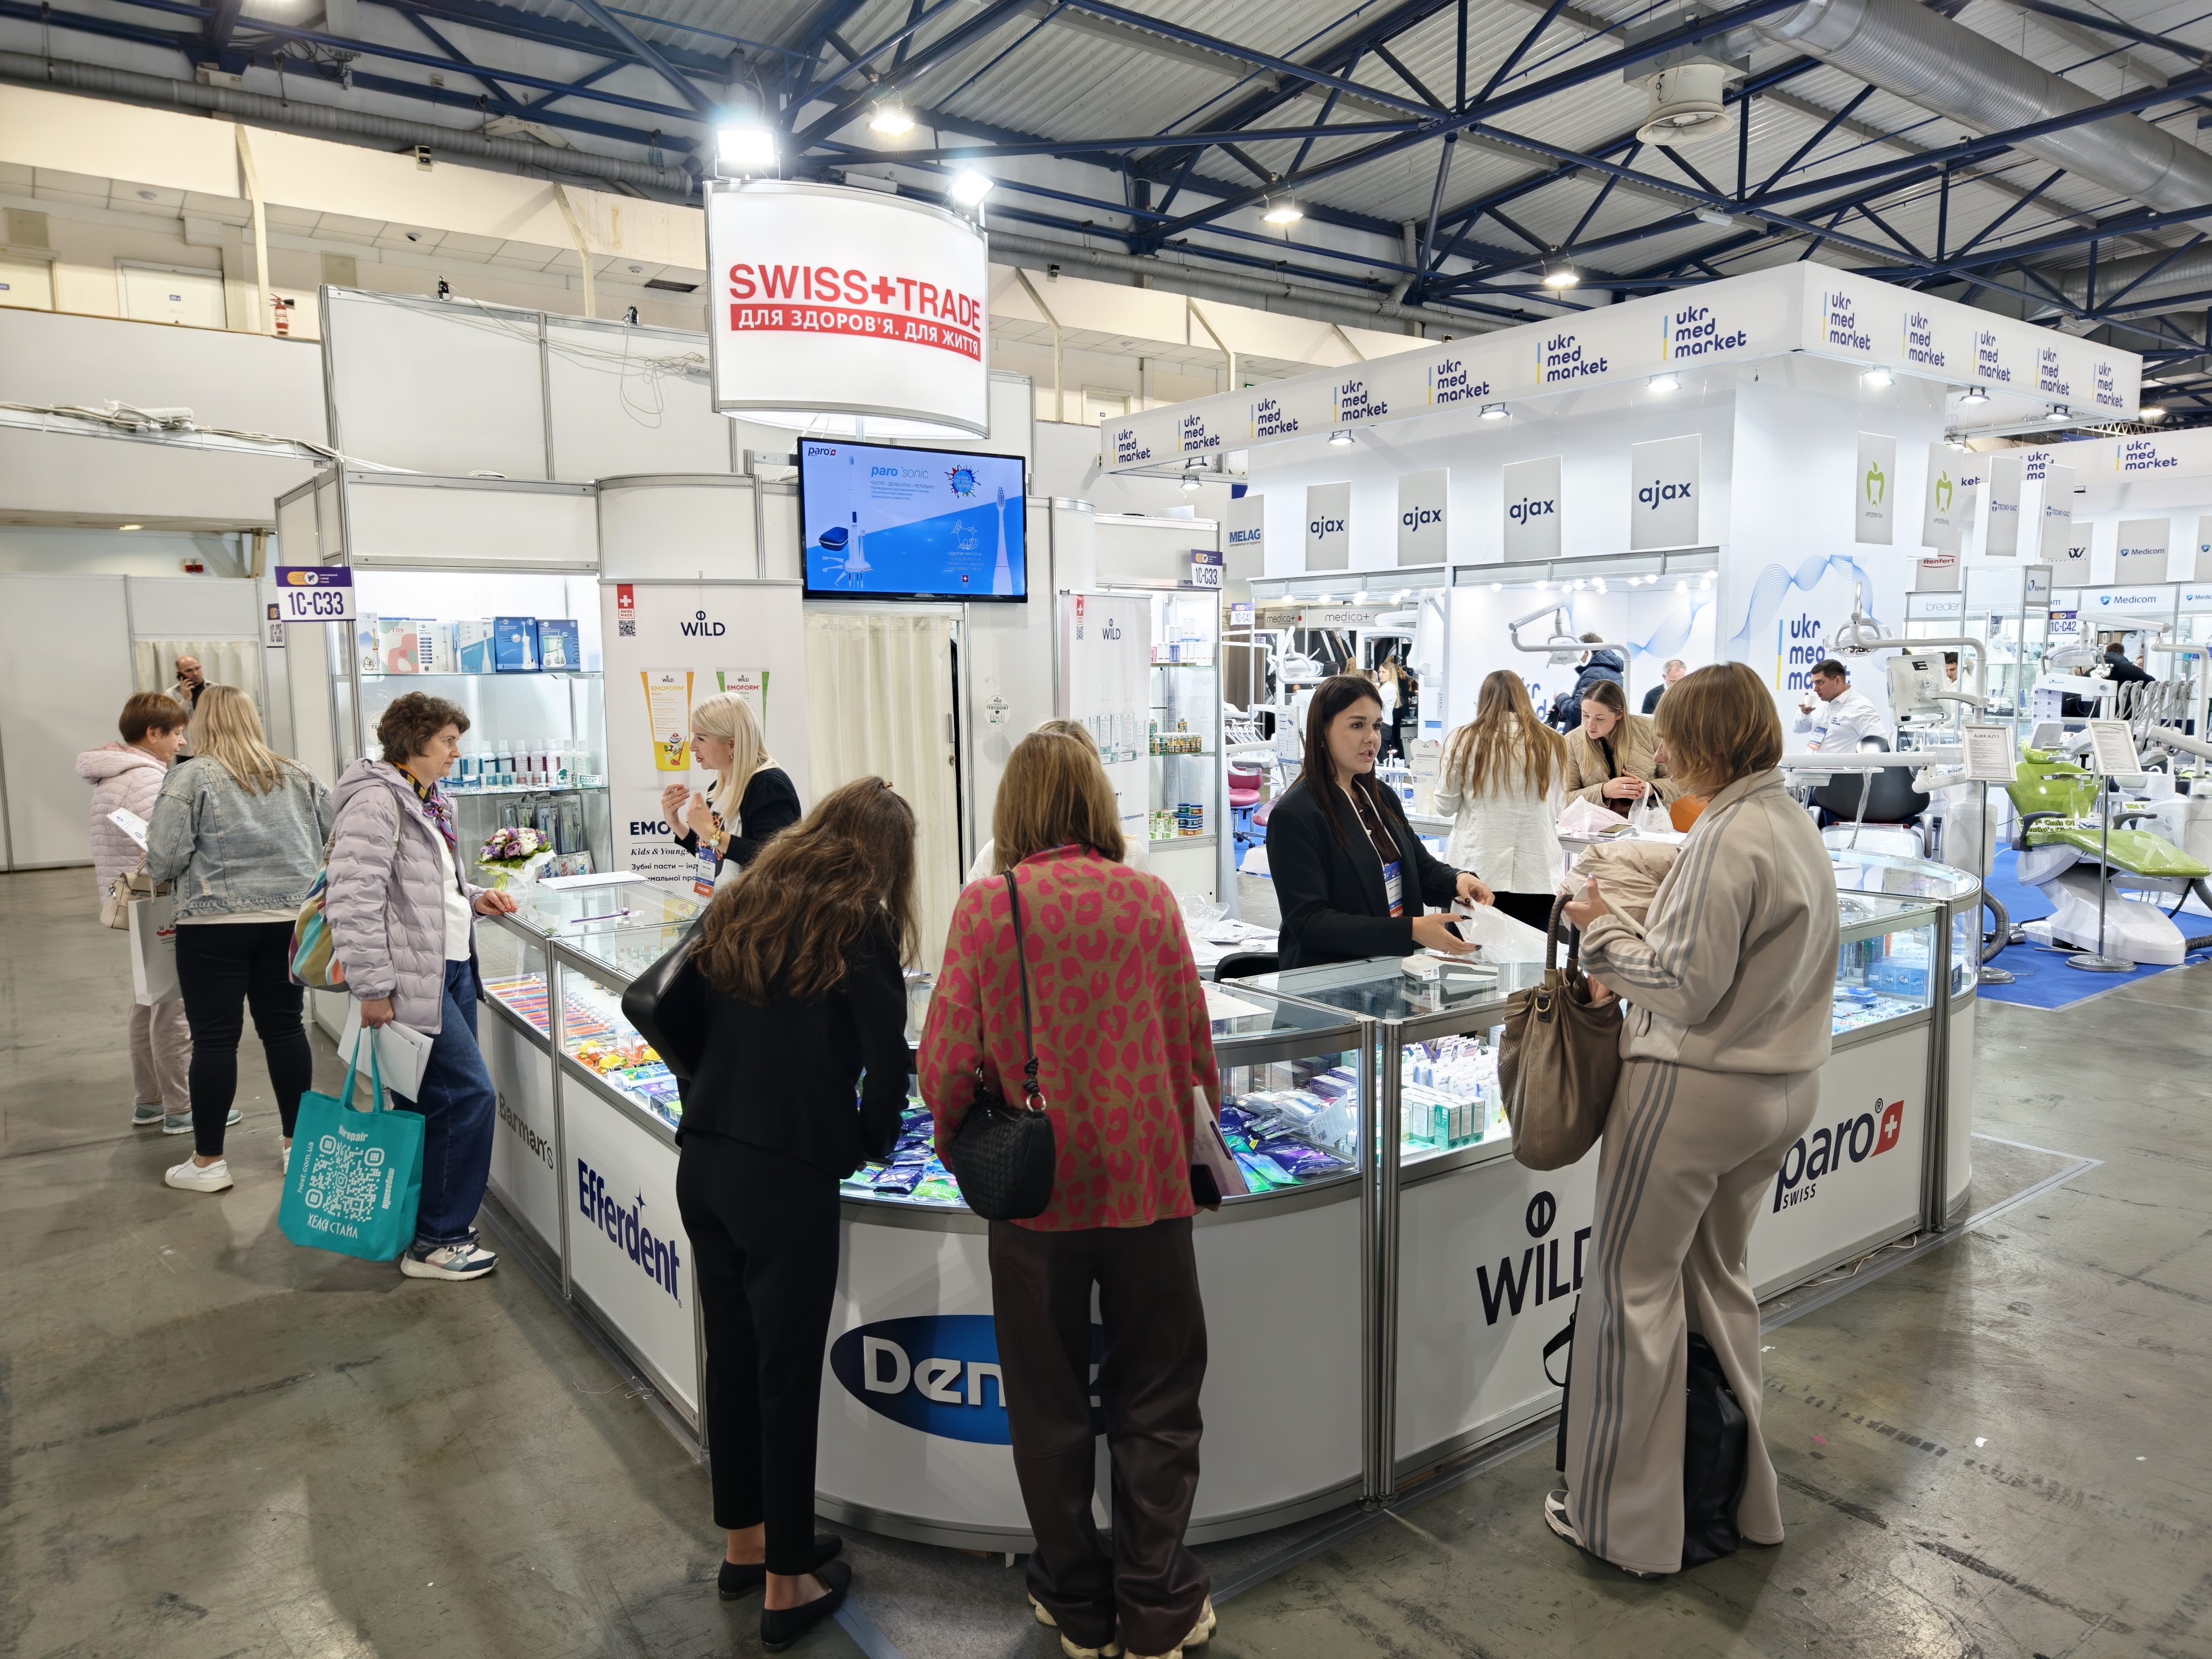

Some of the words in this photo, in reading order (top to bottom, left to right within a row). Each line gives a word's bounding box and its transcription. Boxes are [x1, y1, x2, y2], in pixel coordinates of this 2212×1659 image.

[1832, 291, 1851, 311] ukr
[1676, 306, 1709, 325] ukr
[1831, 312, 1854, 329] med
[1911, 312, 1928, 329] ukr
[738, 307, 783, 329] ДЛЯ
[792, 310, 900, 337] ЗДОРОВ'Я.
[905, 323, 939, 345] ДЛЯ
[941, 329, 979, 357] ЖИТТЯ
[1675, 318, 1716, 342] med
[1981, 330, 1996, 347] ukr
[1548, 334, 1575, 352] ukr
[1675, 330, 1747, 359] market
[1830, 329, 1871, 350] market
[1910, 331, 1931, 347] med
[1547, 345, 1581, 367] med
[1909, 348, 1945, 367] market
[1979, 348, 1999, 363] med
[2043, 347, 2056, 363] ukr
[1438, 359, 1461, 375] ukr
[1547, 357, 1608, 382] market
[1978, 364, 2011, 382] market
[2041, 364, 2059, 379] med
[2099, 362, 2112, 377] ukr
[1342, 380, 1363, 395] ukr
[1437, 369, 1467, 389] med
[2040, 379, 2069, 396] market
[2098, 378, 2113, 392] med
[1342, 390, 1367, 408] med
[1437, 381, 1490, 404] market
[2096, 392, 2123, 408] market
[1258, 398, 1277, 412] ukr
[1341, 401, 1388, 422] market
[1184, 414, 1201, 428] ukr
[1258, 408, 1280, 425] med
[1118, 429, 1133, 441] ukr
[1184, 424, 1204, 440] med
[1258, 419, 1298, 437] market
[1118, 437, 1137, 453] med
[1184, 434, 1220, 451] market
[2127, 440, 2151, 451] ukr
[808, 447, 830, 456] paro
[1118, 447, 1151, 464] market
[2028, 451, 2049, 462] ukr
[2126, 448, 2156, 461] med
[2125, 457, 2178, 470] market
[871, 466, 898, 477] paro
[902, 468, 928, 479] sonic
[1961, 476, 1981, 487] ket
[1638, 477, 1692, 510] ajax
[1509, 497, 1555, 525] ajax
[1998, 503, 2018, 511] TECNO-GAZ
[2052, 509, 2070, 517] TECNO-GAZ
[1310, 515, 1344, 540] ajax
[1403, 506, 1442, 533] ajax
[1229, 528, 1261, 543] MELAG
[1195, 567, 1217, 585] 1C-C33
[288, 592, 344, 615] 1C-C33
[2114, 596, 2156, 604] Medicom
[1235, 613, 1252, 622] 1C-C42
[1791, 613, 1821, 639] ukr
[680, 622, 726, 636] WILD
[1102, 628, 1121, 640] WILD
[2051, 621, 2076, 632] 1C-C42
[1123, 813, 1144, 821] порожниною
[660, 848, 690, 856] Youngs
[631, 863, 652, 871] Зубні
[1773, 1114, 1876, 1214] paro
[1782, 1183, 1817, 1210] SWISS
[329, 1222, 358, 1239] СТАЙЛ
[577, 1157, 680, 1302] Efferdent
[862, 1334, 1006, 1407] Den
